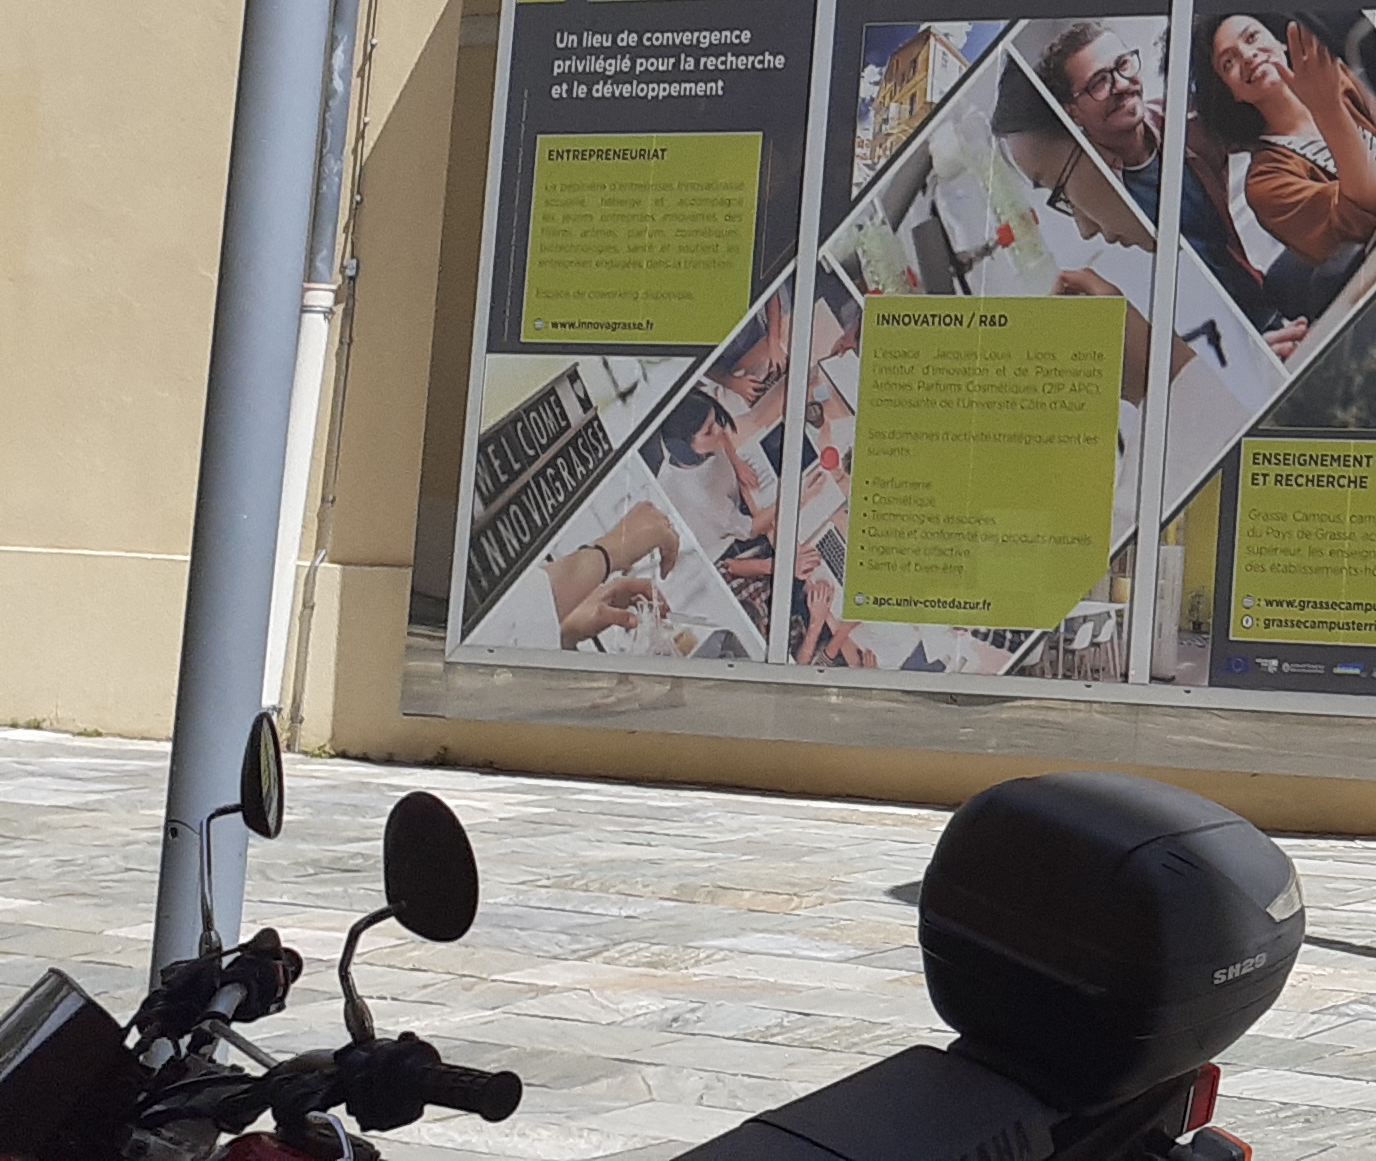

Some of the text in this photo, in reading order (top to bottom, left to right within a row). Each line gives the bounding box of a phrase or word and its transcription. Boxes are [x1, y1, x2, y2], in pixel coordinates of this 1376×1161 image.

[555, 29, 751, 49] Un lieu de convergence
[552, 52, 785, 77] privilégié pour la recherche
[550, 78, 724, 100] et le développement
[548, 148, 667, 161] ENTREPRENEURIAT
[551, 319, 654, 331] www.innovagrasse.fr
[877, 312, 1008, 328] INNOVATION / R&D
[477, 393, 571, 496] WELCOME
[1252, 453, 1373, 469] ENSEIGNEMENT
[1251, 473, 1369, 489] ET RECHERCHE
[470, 420, 611, 589] INNOVAGRASSE
[1249, 508, 1288, 523] Grasse
[873, 596, 991, 611] apc.univ-cotedazur.fr
[1213, 952, 1267, 985] SH29
